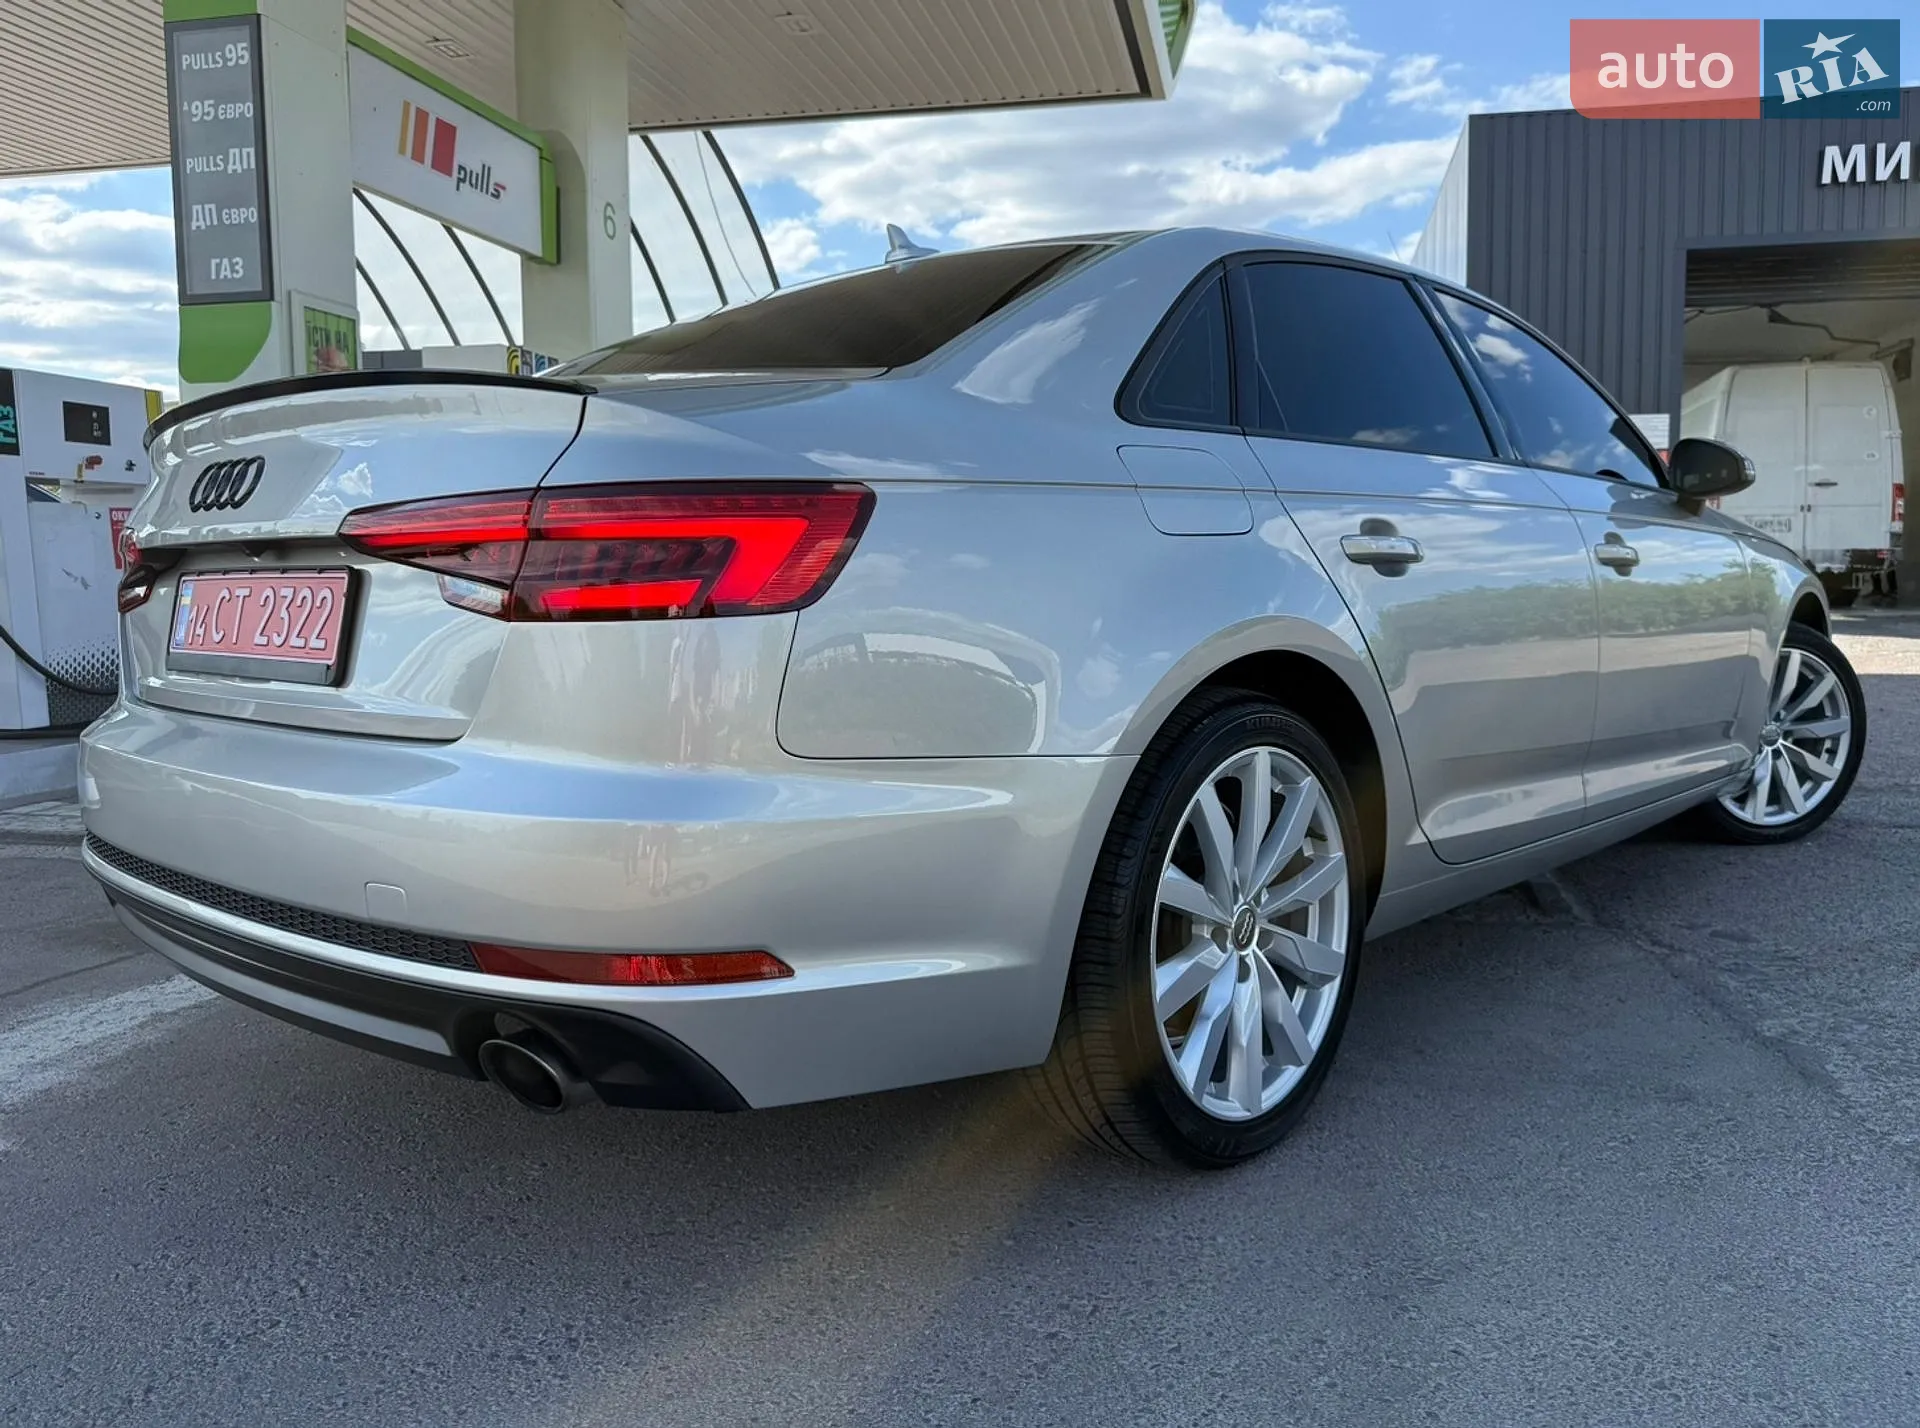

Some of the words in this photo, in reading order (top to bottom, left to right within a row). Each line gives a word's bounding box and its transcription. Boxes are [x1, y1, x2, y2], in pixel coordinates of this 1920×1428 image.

[182, 51, 223, 71] PULLS
[225, 42, 250, 67] 95
[185, 155, 225, 174] PULLS
[226, 147, 256, 174] ДП
[455, 163, 507, 200] pulls
[191, 203, 218, 230] ДП
[603, 200, 617, 241] 6
[209, 256, 244, 280] ГАЗ
[253, 586, 335, 651] 2322
